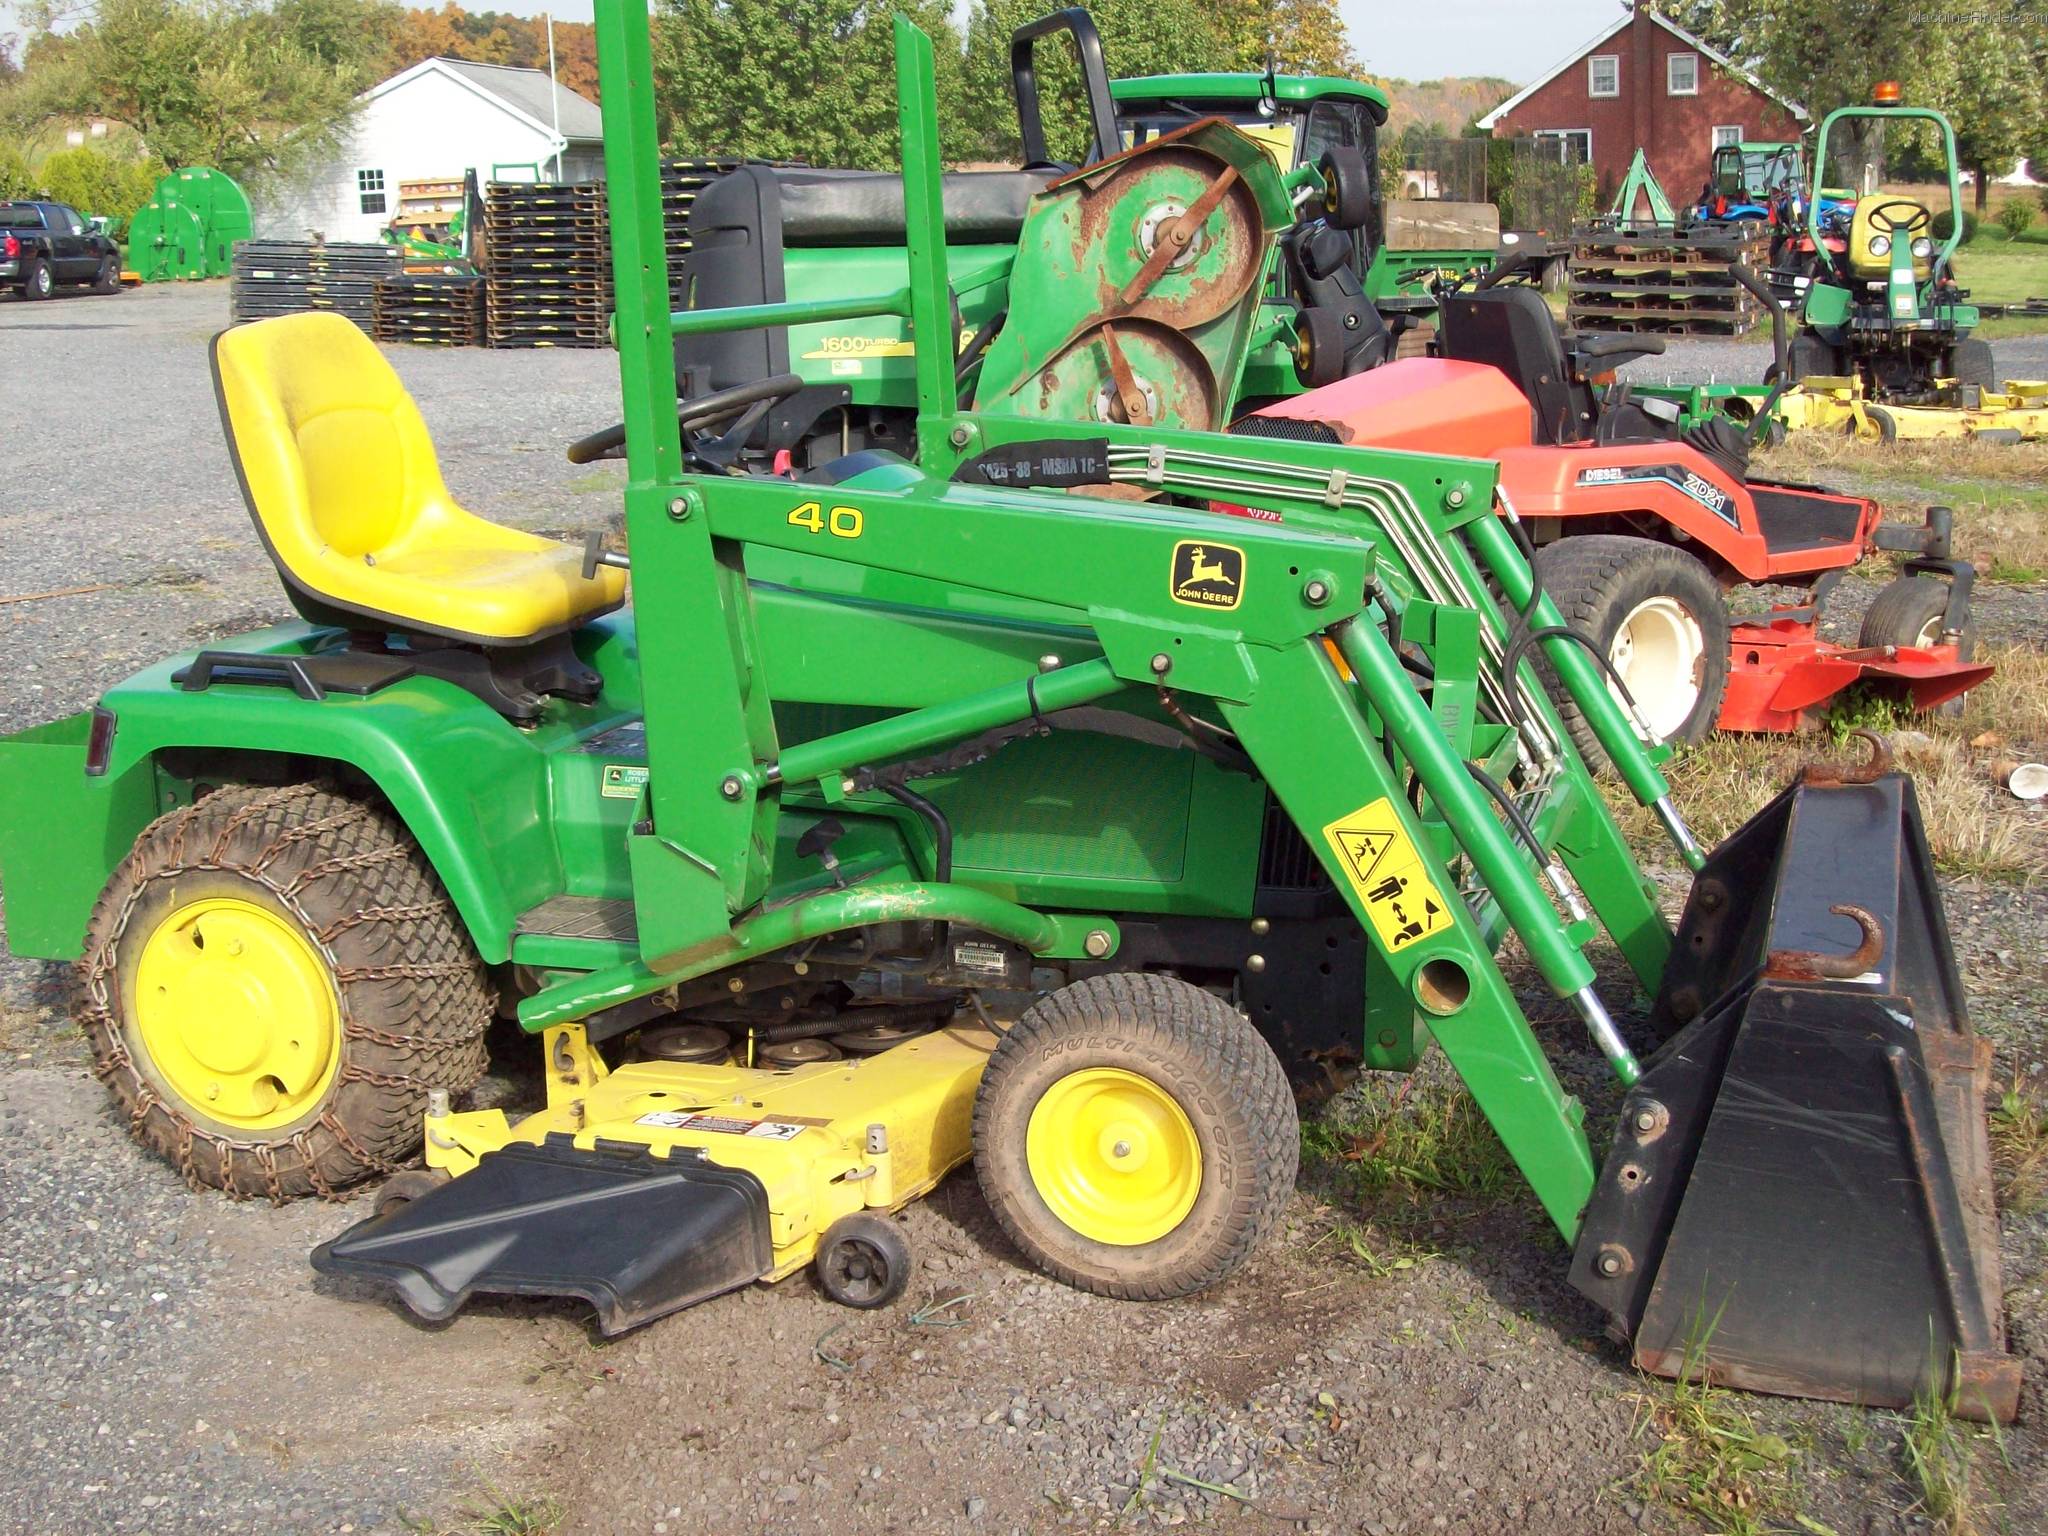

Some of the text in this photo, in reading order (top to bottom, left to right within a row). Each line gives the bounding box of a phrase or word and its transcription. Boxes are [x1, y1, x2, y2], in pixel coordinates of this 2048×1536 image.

[820, 336, 898, 353] 1600 TURBO
[1585, 467, 1625, 482] DIESEL
[1682, 473, 1726, 511] ZD21
[787, 501, 864, 540] 40
[1175, 588, 1235, 605] JOHN DEERE
[1042, 1036, 1134, 1062] MULTI
